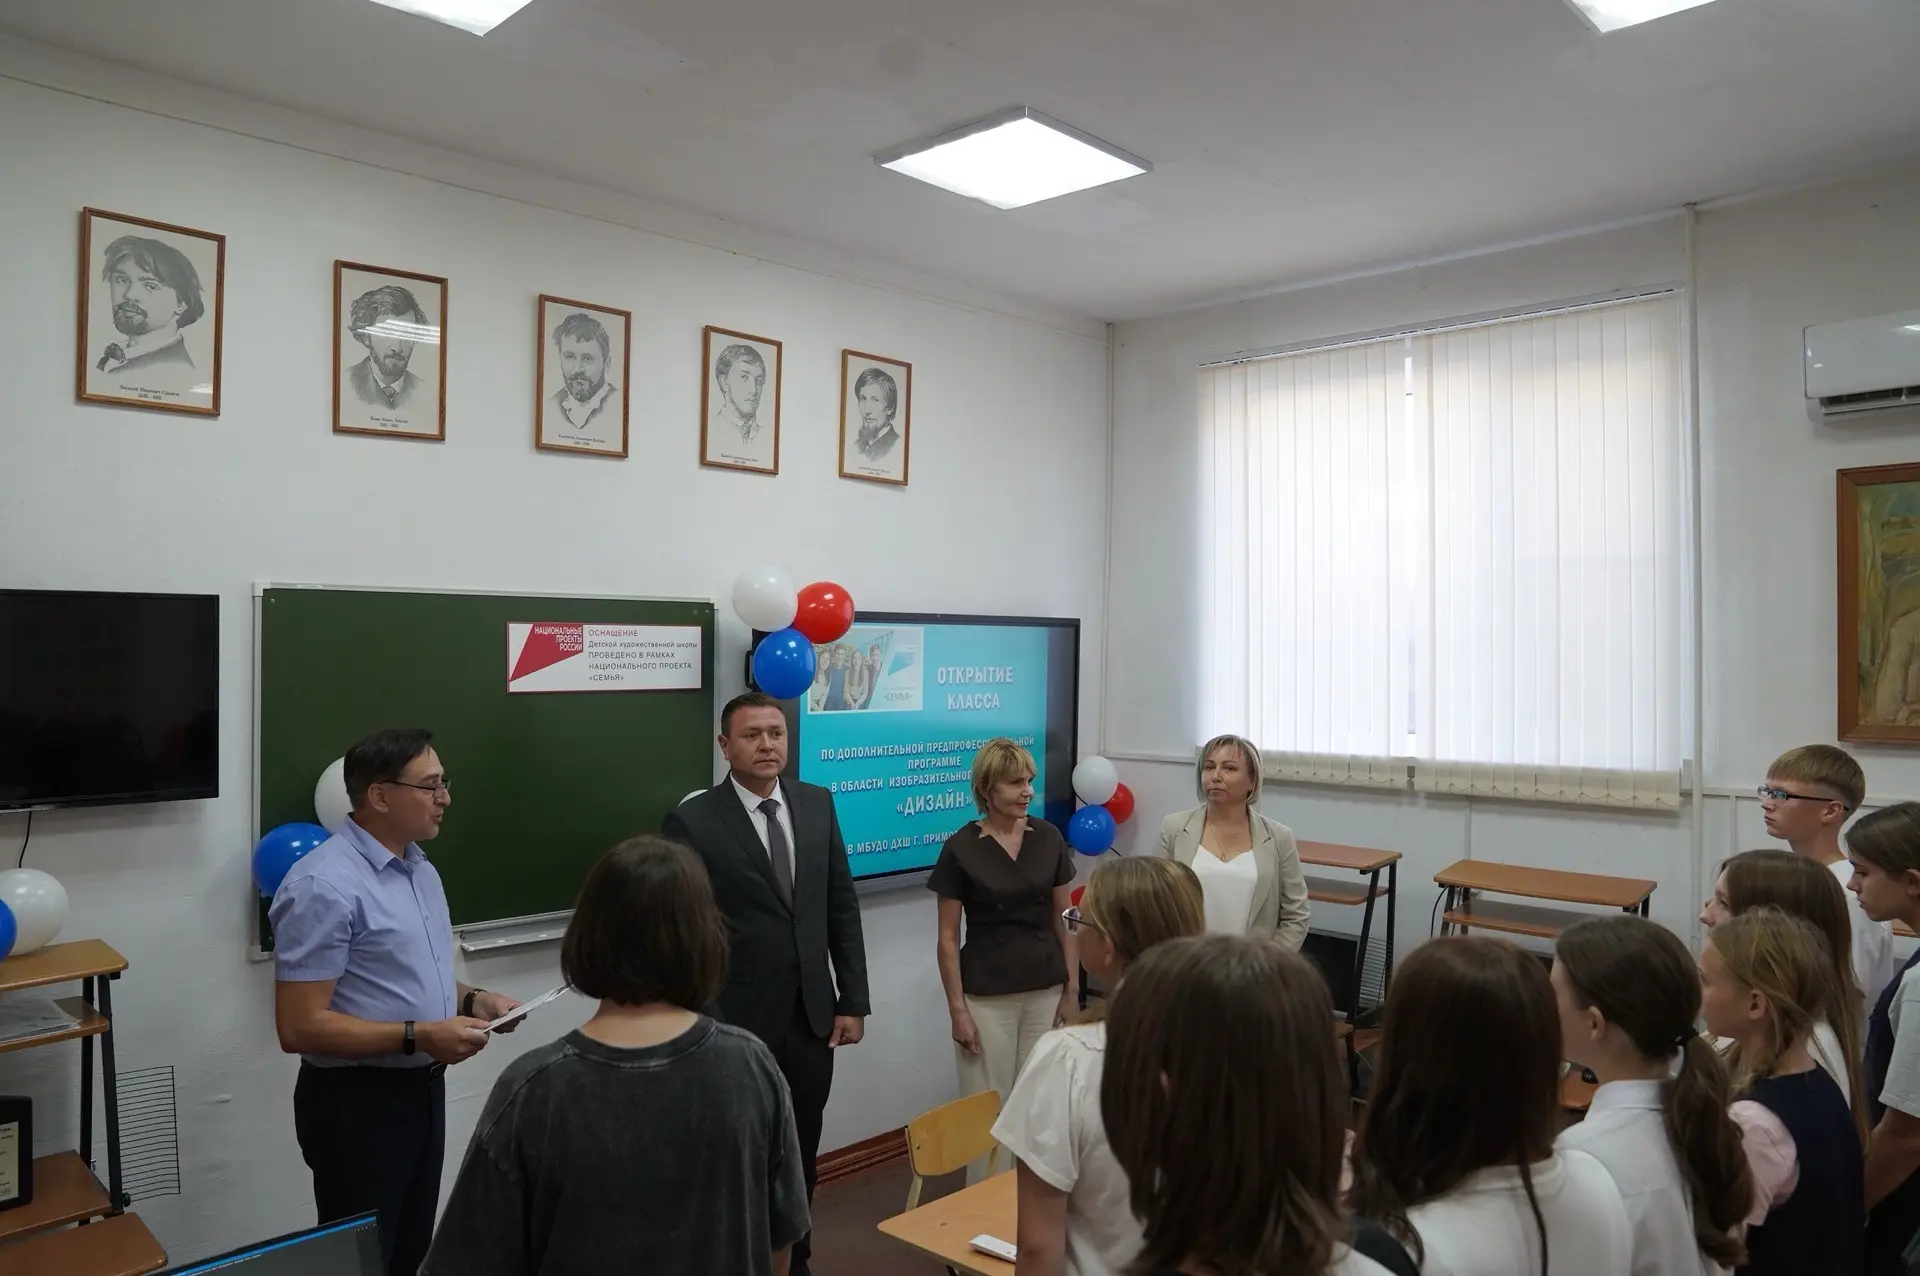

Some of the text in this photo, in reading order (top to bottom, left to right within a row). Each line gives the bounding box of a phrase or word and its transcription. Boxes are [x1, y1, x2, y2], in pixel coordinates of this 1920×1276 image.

[534, 626, 583, 635] НАЦИОНАЛЬНЫЕ
[588, 629, 638, 637] ОСНАЩЕНИЕ
[556, 634, 583, 643] ПРОЕКТЫ
[559, 643, 583, 651] РОССИИ
[588, 640, 618, 649] Детской
[619, 642, 675, 650] художественной
[588, 651, 637, 660] ПРОВЕДЕНО
[588, 662, 657, 671] НАЦИОНАЛЬНОГО
[588, 673, 624, 682] «СЕМЬЯ»
[937, 666, 1014, 685] ОТКРЫТИЕ
[948, 692, 1000, 710] КЛАССА
[821, 749, 835, 761] ПО
[837, 741, 924, 761] ДОПОЛНИТЕЛЬНОЙ
[907, 756, 962, 770] ПРОГРАММЕ
[831, 770, 972, 793] В ОБЛАСТИ ИЗОБРАЗИТЕЛЬНОГ
[896, 789, 972, 816] «ДИЗАЙН»
[847, 844, 854, 855] В
[856, 839, 888, 854] МБУДО
[890, 836, 911, 850] ДХШ
[913, 835, 921, 846] Г.
